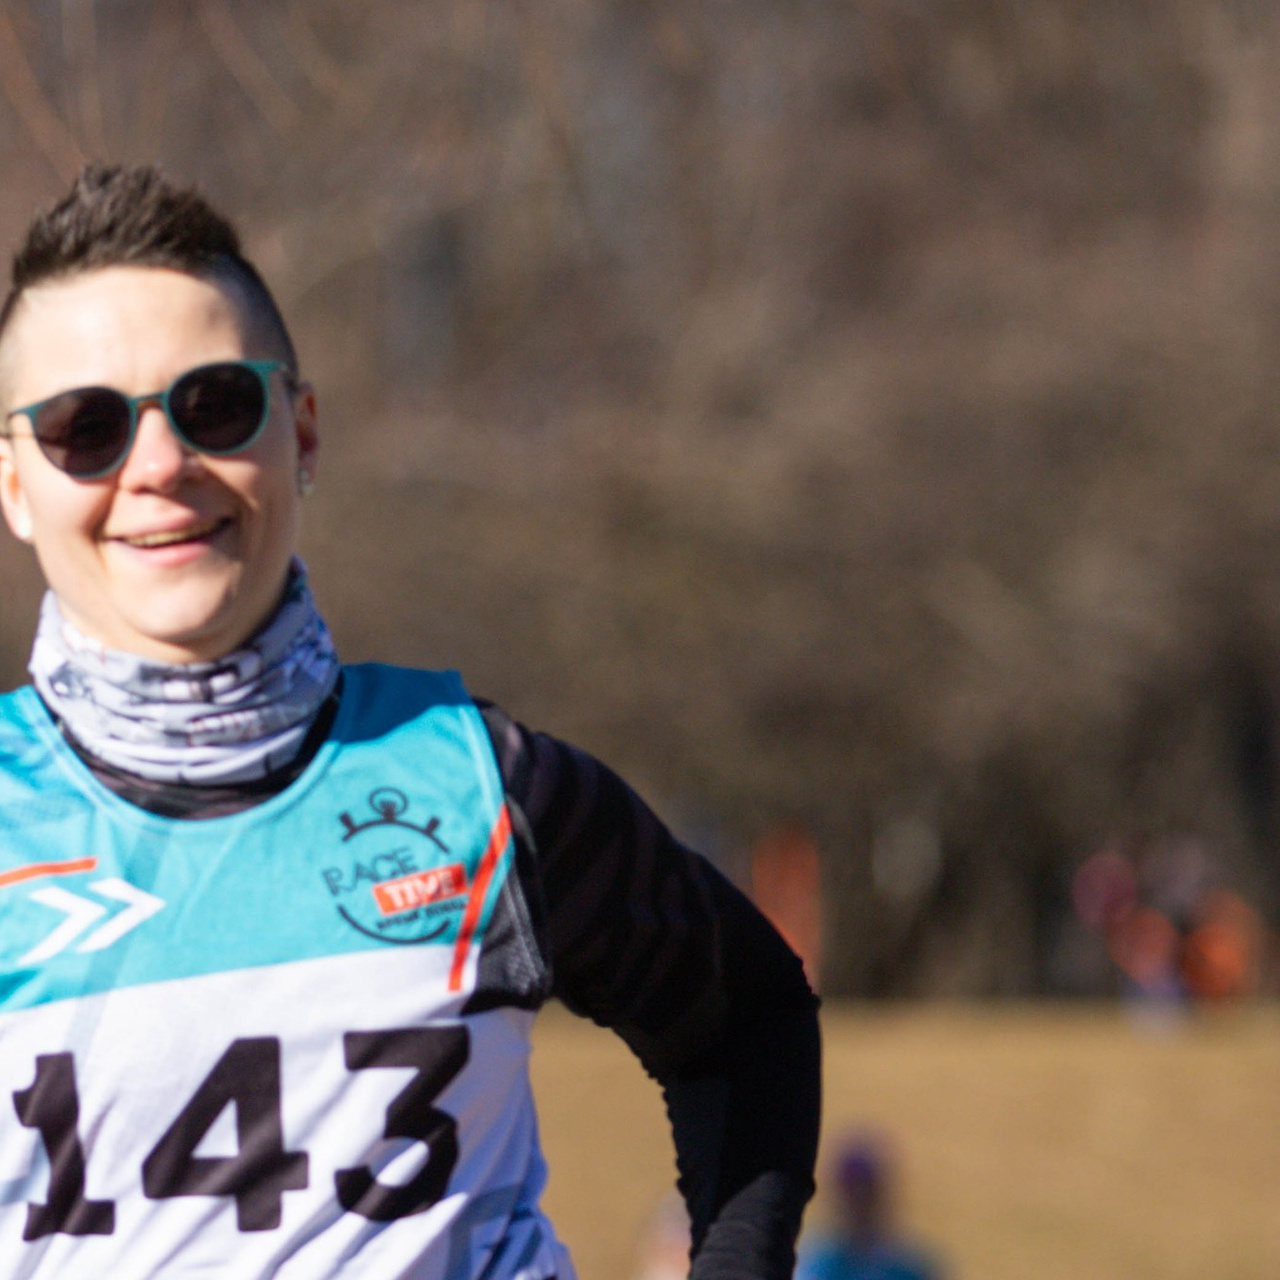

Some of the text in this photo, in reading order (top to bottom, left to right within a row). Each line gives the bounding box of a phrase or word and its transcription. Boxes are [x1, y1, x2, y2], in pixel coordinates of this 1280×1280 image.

[322, 846, 419, 897] RACE
[383, 869, 455, 909] TIME
[12, 1024, 471, 1242] 143
